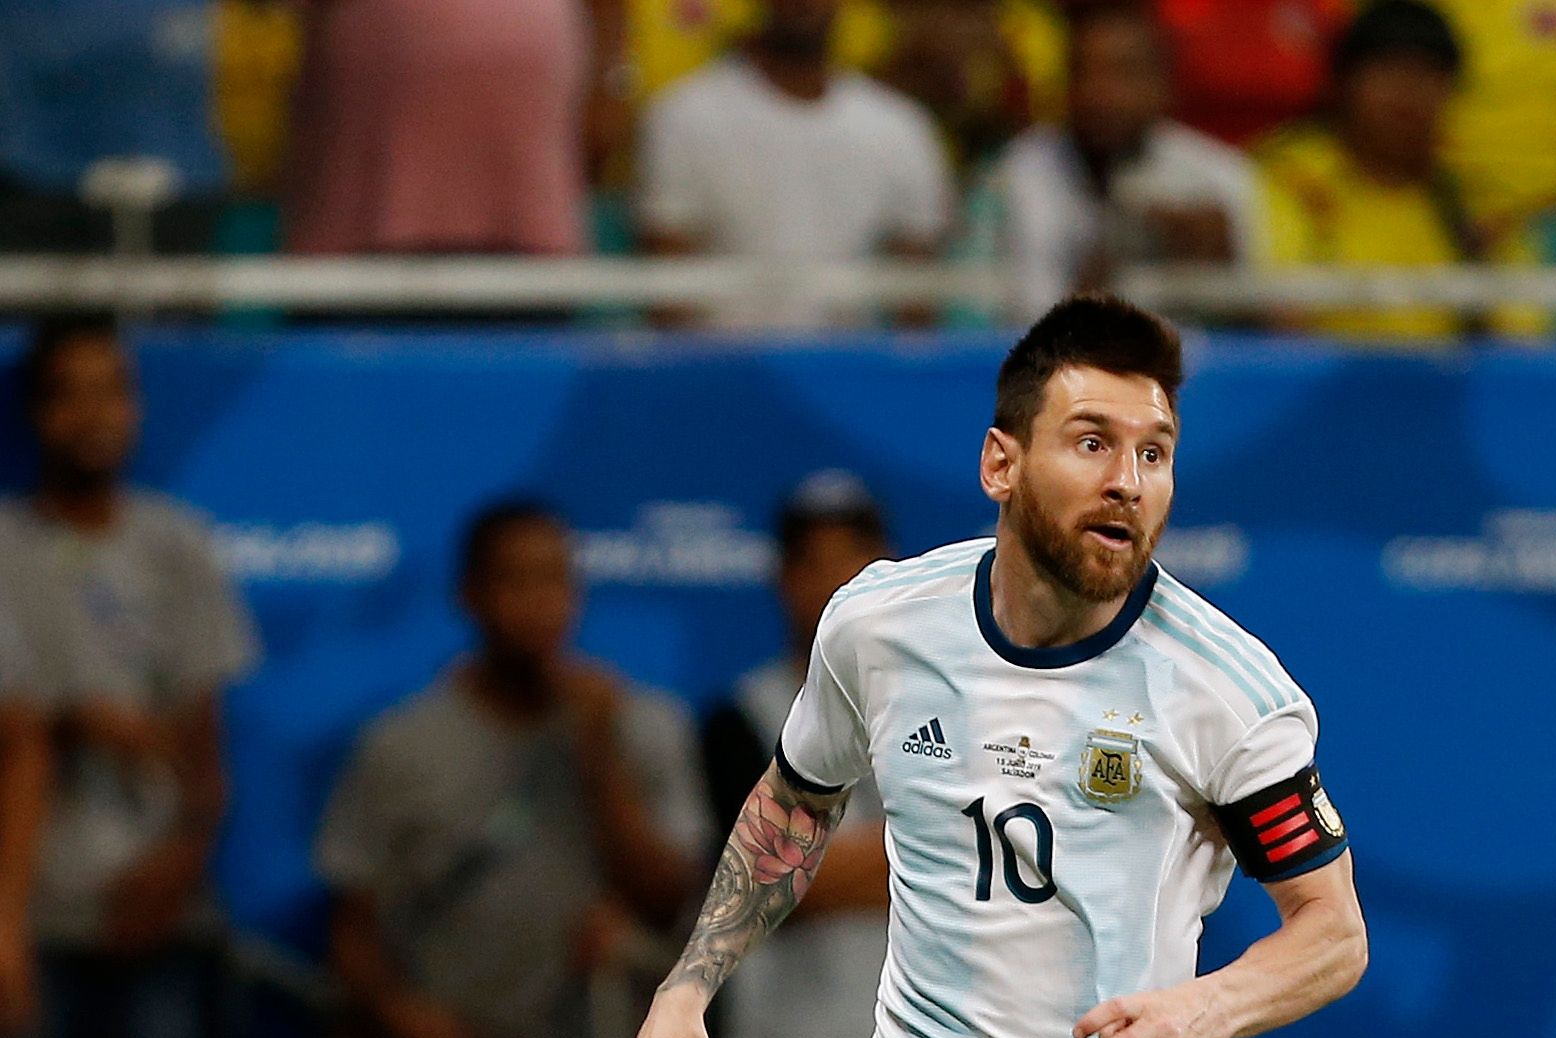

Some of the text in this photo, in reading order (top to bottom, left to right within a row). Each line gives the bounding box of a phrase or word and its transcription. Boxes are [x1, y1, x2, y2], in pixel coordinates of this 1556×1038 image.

[902, 739, 952, 759] adidas
[983, 743, 1016, 754] ARGENTINA
[1091, 749, 1126, 786] AFA
[961, 795, 1058, 904] 10
